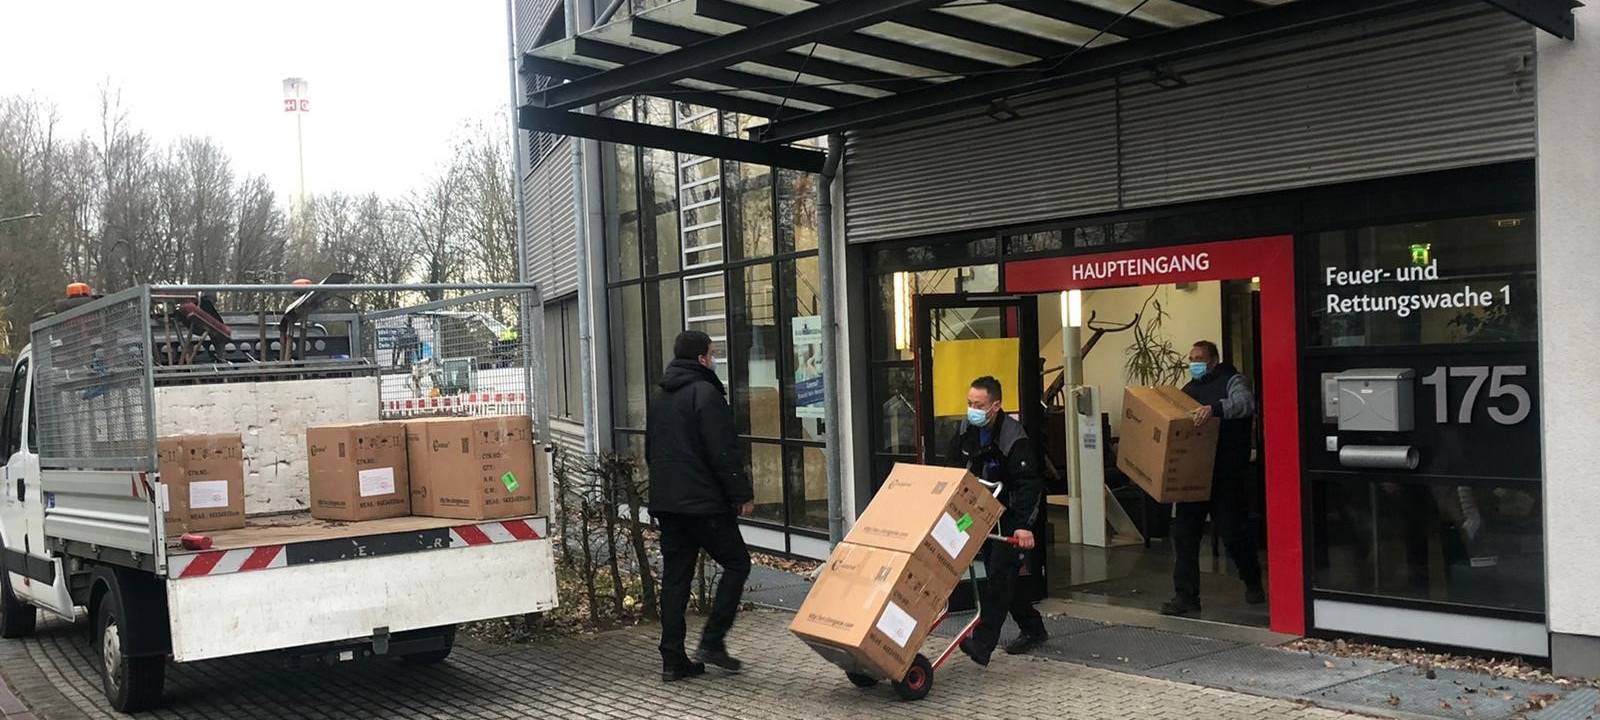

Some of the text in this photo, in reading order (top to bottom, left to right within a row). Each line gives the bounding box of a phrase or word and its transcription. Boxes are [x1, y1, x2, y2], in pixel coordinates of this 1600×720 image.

[1072, 252, 1210, 281] HAUPTEINGANG
[1326, 258, 1439, 286] Feuer- und
[1326, 285, 1511, 317] Rettungswache 1
[1421, 365, 1531, 425] 175
